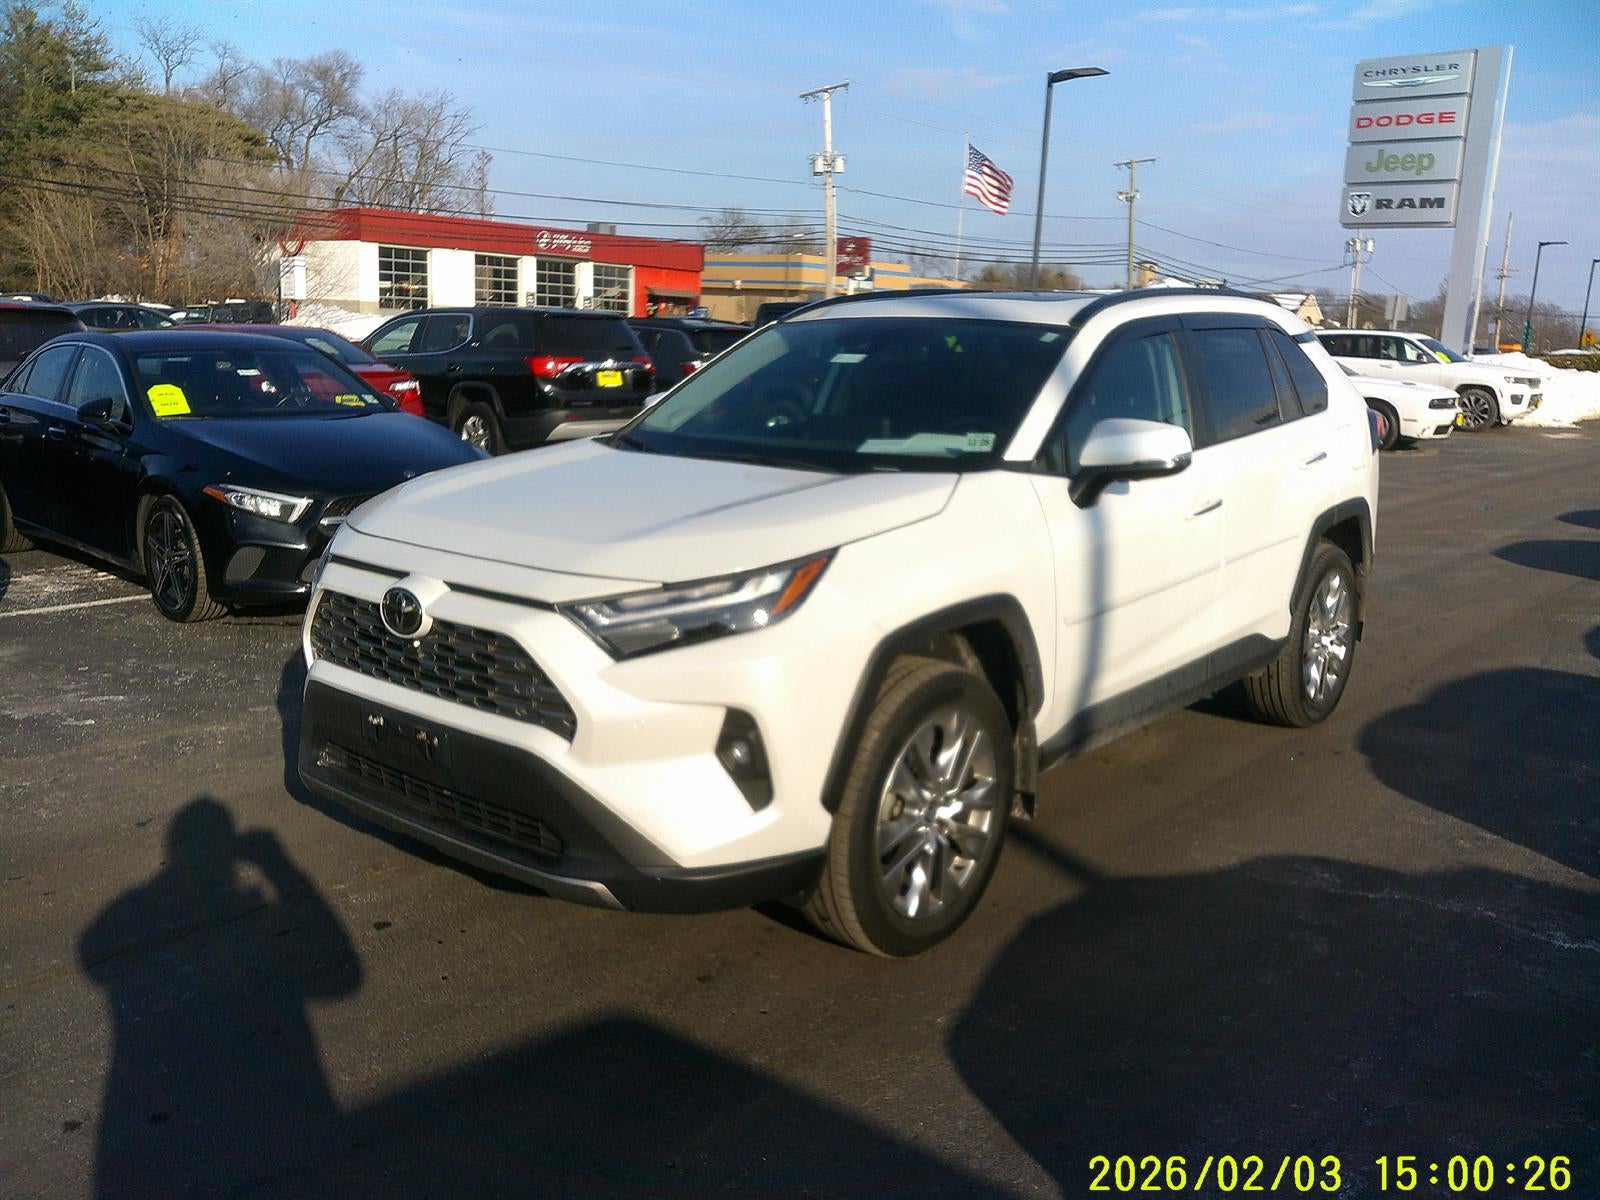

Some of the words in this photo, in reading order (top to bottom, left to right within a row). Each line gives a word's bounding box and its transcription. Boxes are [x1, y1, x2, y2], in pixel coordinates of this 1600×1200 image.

[1363, 63, 1460, 78] CHRYSLER
[1355, 111, 1457, 129] DODGE
[1365, 149, 1436, 176] Jeep
[1375, 197, 1446, 210] RAM
